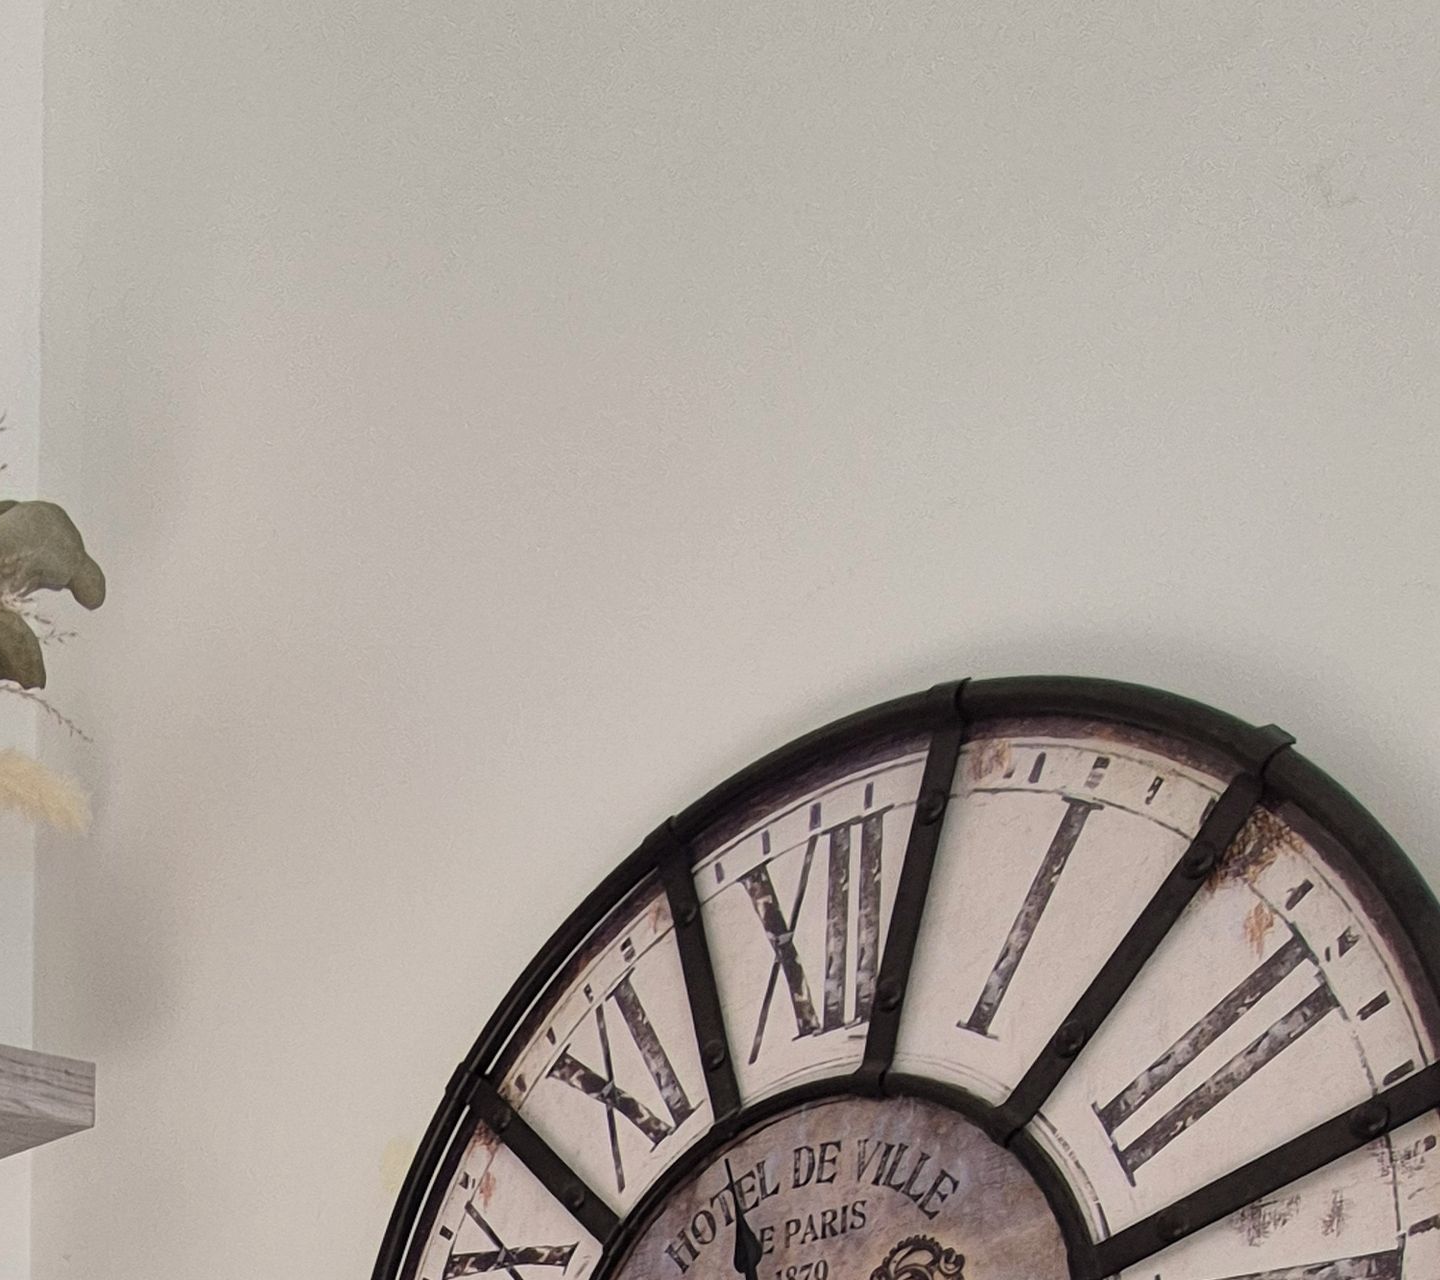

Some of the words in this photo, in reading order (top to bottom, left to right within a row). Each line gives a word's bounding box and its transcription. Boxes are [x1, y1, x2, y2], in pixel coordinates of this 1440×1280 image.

[736, 803, 895, 1064] XII
[546, 966, 705, 1193] XI
[1091, 921, 1348, 1187] II
[664, 1160, 780, 1274] HOTEL
[791, 1140, 843, 1189] DE
[856, 1138, 959, 1220] VILLE
[785, 1200, 867, 1249] PARIS
